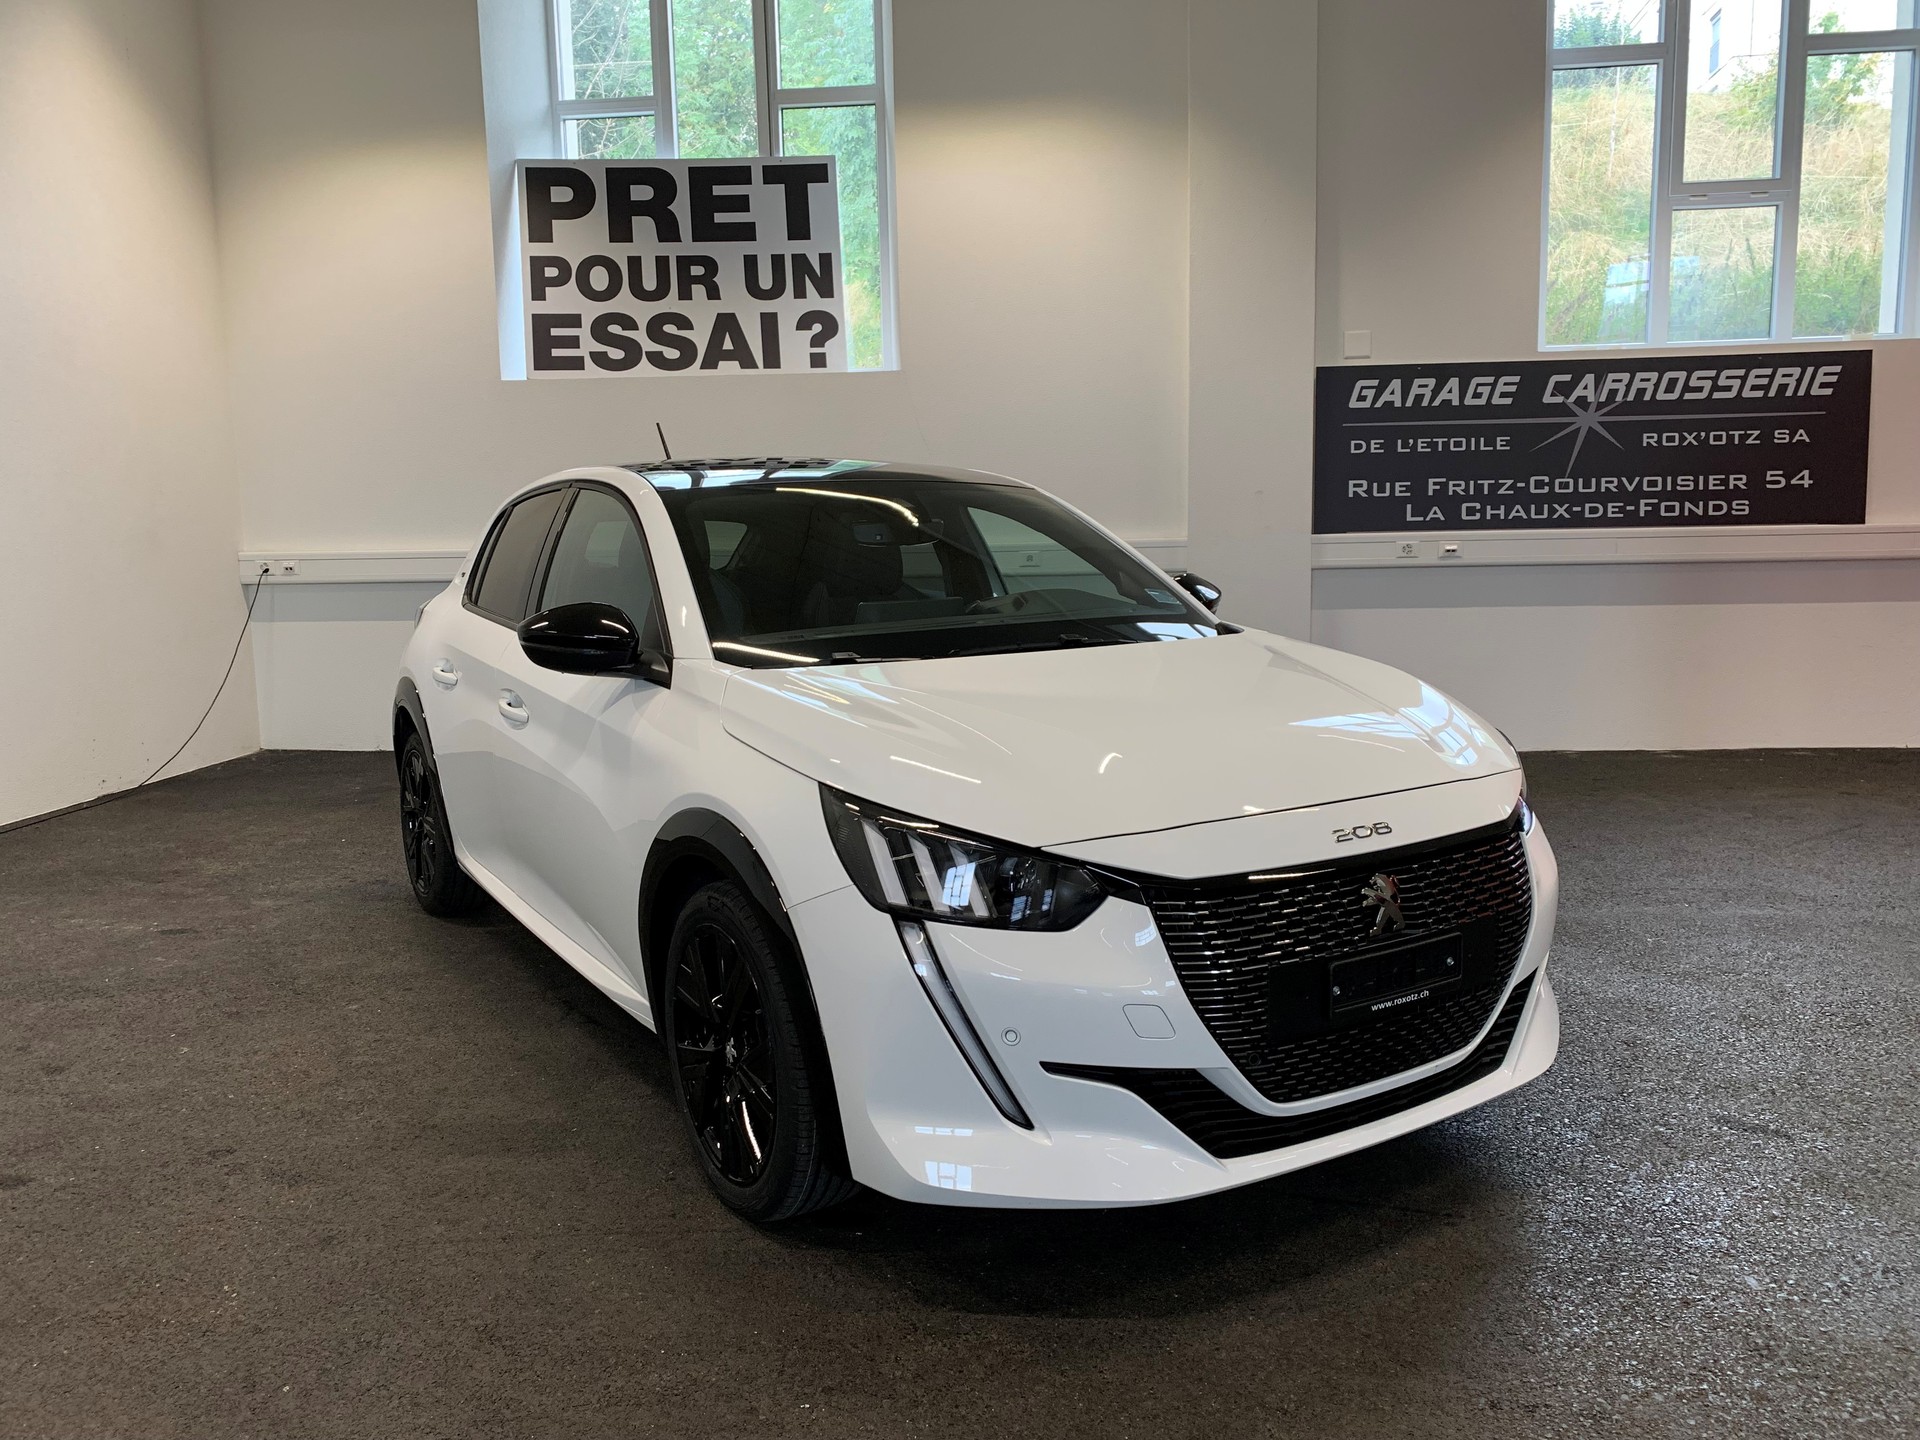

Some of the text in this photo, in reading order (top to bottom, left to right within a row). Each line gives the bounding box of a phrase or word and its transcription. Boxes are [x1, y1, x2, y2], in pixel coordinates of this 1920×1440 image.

[525, 163, 829, 243] PRET
[529, 252, 835, 302] POUR UN
[1348, 365, 1843, 409] GARAGE CARROSSERIE
[1350, 436, 1511, 454] DE L'ETOILE
[1642, 428, 1811, 447] ROX'OTZ SA
[1765, 469, 1814, 489] 54
[1331, 821, 1393, 843] 208
[1371, 989, 1430, 1012] www.roxotz.ch
